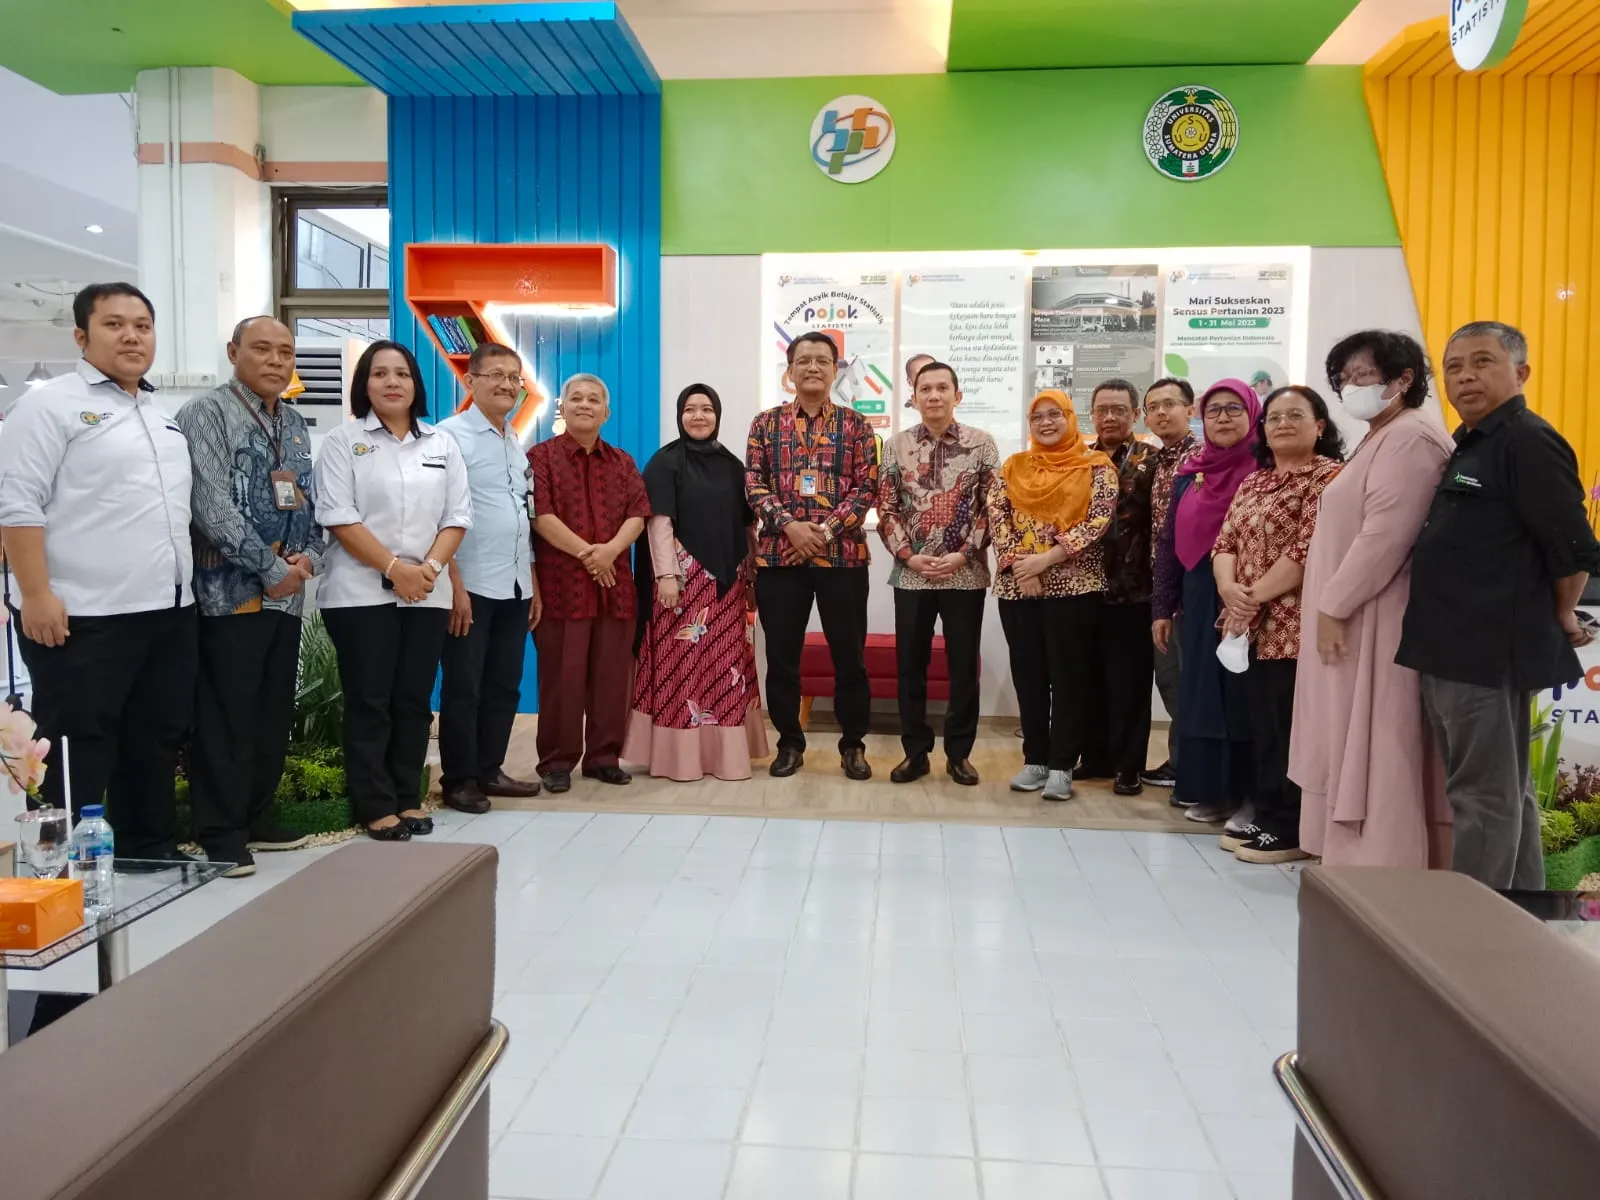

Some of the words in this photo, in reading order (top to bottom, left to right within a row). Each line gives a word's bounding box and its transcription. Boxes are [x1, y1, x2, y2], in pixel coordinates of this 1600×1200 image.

[1452, 0, 1500, 46] STATIST
[1167, 106, 1214, 124] UNIVERSITAS
[1164, 134, 1198, 159] SUMATERA
[1200, 132, 1217, 156] UTARA
[784, 300, 808, 325] Tempat
[808, 292, 829, 304] Asyik
[830, 291, 858, 301] Belajar
[859, 298, 884, 324] Statistik
[1189, 296, 1212, 305] Mari
[1214, 296, 1270, 305] Sukseskan
[1210, 306, 1259, 315] Pertanian
[1552, 708, 1600, 724] STA
